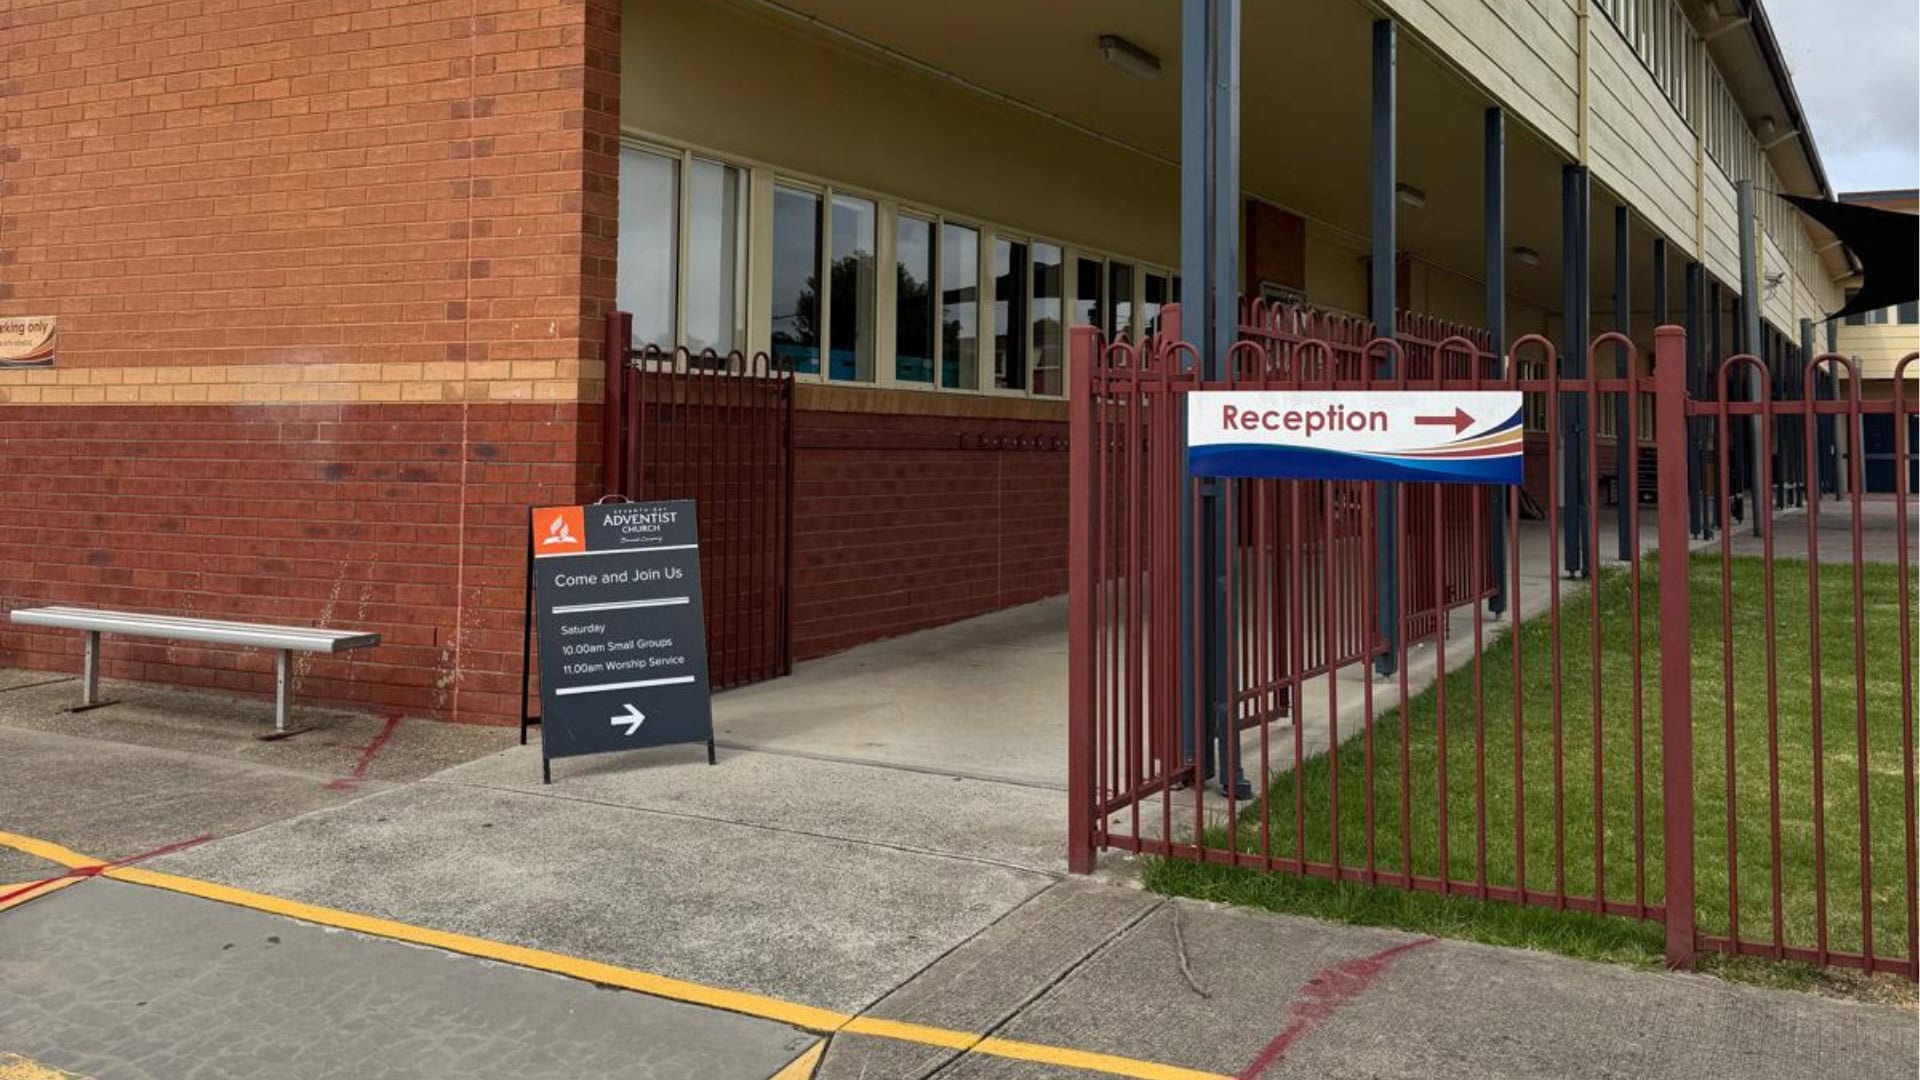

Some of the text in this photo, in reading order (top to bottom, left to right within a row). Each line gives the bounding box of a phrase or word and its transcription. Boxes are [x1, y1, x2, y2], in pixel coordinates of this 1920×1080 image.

[28, 320, 49, 336] only
[1222, 403, 1388, 437] Reception
[602, 511, 678, 527] ADVENTIST
[621, 524, 661, 534] CHURCH
[554, 566, 683, 588] Come and Join Us
[560, 624, 606, 636] Saturday
[562, 638, 673, 656] 10.00am Small Groups
[563, 656, 685, 675] 11.00am Worship Service
